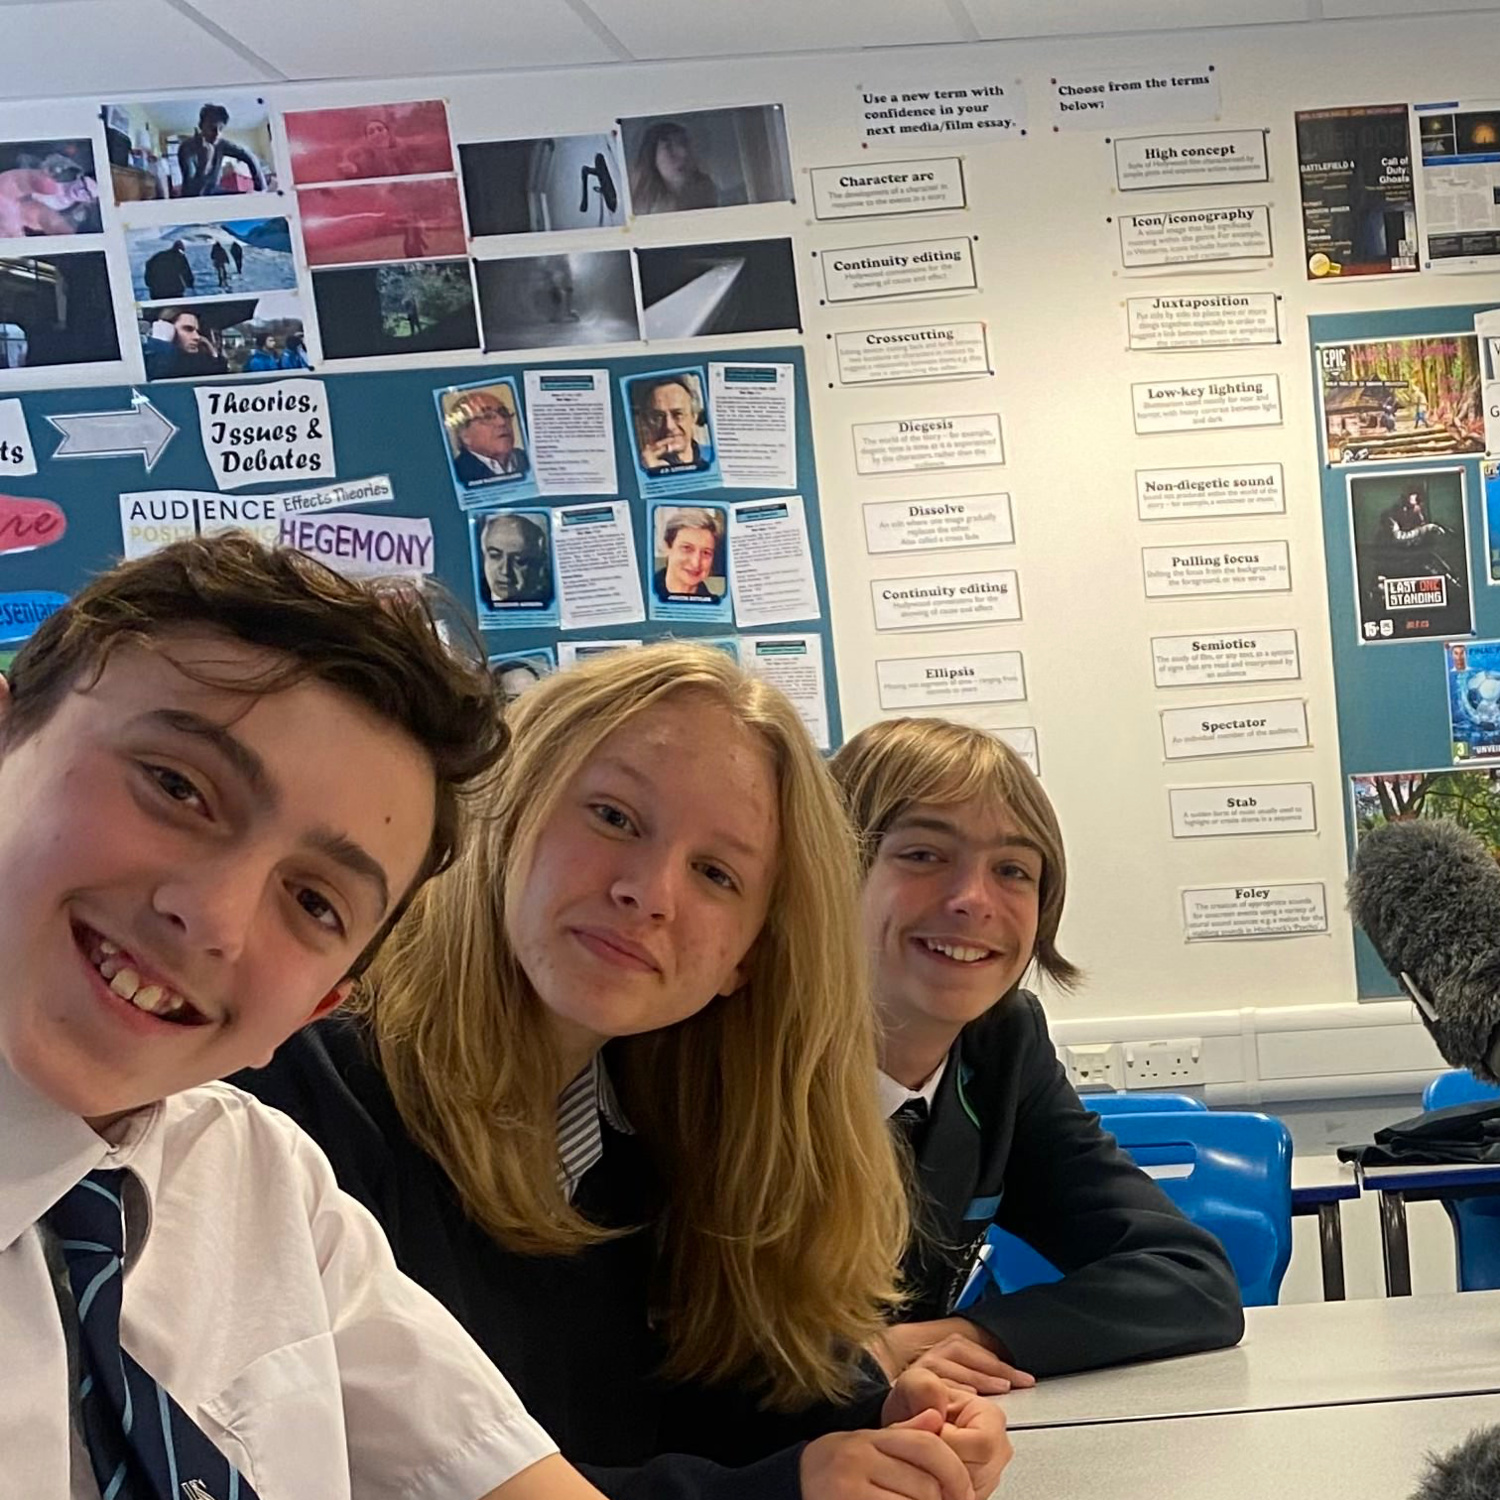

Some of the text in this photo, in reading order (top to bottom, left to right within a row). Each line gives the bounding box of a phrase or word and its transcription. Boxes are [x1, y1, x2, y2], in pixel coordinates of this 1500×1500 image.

[1058, 74, 1210, 96] Choose from the terms
[863, 85, 1004, 105] Use a new term with
[865, 104, 989, 120] confidence in your
[866, 118, 1016, 136] next media/film essay.
[1145, 144, 1236, 161] High concept
[839, 171, 934, 188] Character arc
[1132, 208, 1255, 227] Icon/iconography
[834, 249, 962, 272] Continuity editing
[1152, 295, 1250, 310] Juxtaposition
[866, 329, 955, 346] Crosscutting
[1322, 349, 1347, 369] EPIC
[1148, 381, 1263, 400] Low-key lighting
[211, 418, 323, 446] Issues &
[899, 420, 953, 434] Diegesis
[221, 449, 323, 474] Debates
[1145, 475, 1275, 493] Non-diegetic sound
[283, 483, 390, 513] Effects Theories
[130, 498, 277, 530] AUDIENCE
[909, 504, 965, 517] Dissolve
[279, 517, 433, 568] HEGEMONY
[1171, 552, 1260, 569] Pulling focus
[882, 581, 1009, 601] Continuity editing
[1389, 581, 1417, 594] LAST
[1390, 592, 1442, 606] STANDING
[1192, 638, 1257, 652] Semiotics
[925, 666, 975, 680] Ellipsis
[1201, 717, 1267, 732] Spectator
[1226, 797, 1257, 809] Stab
[1235, 888, 1270, 900] Foley
